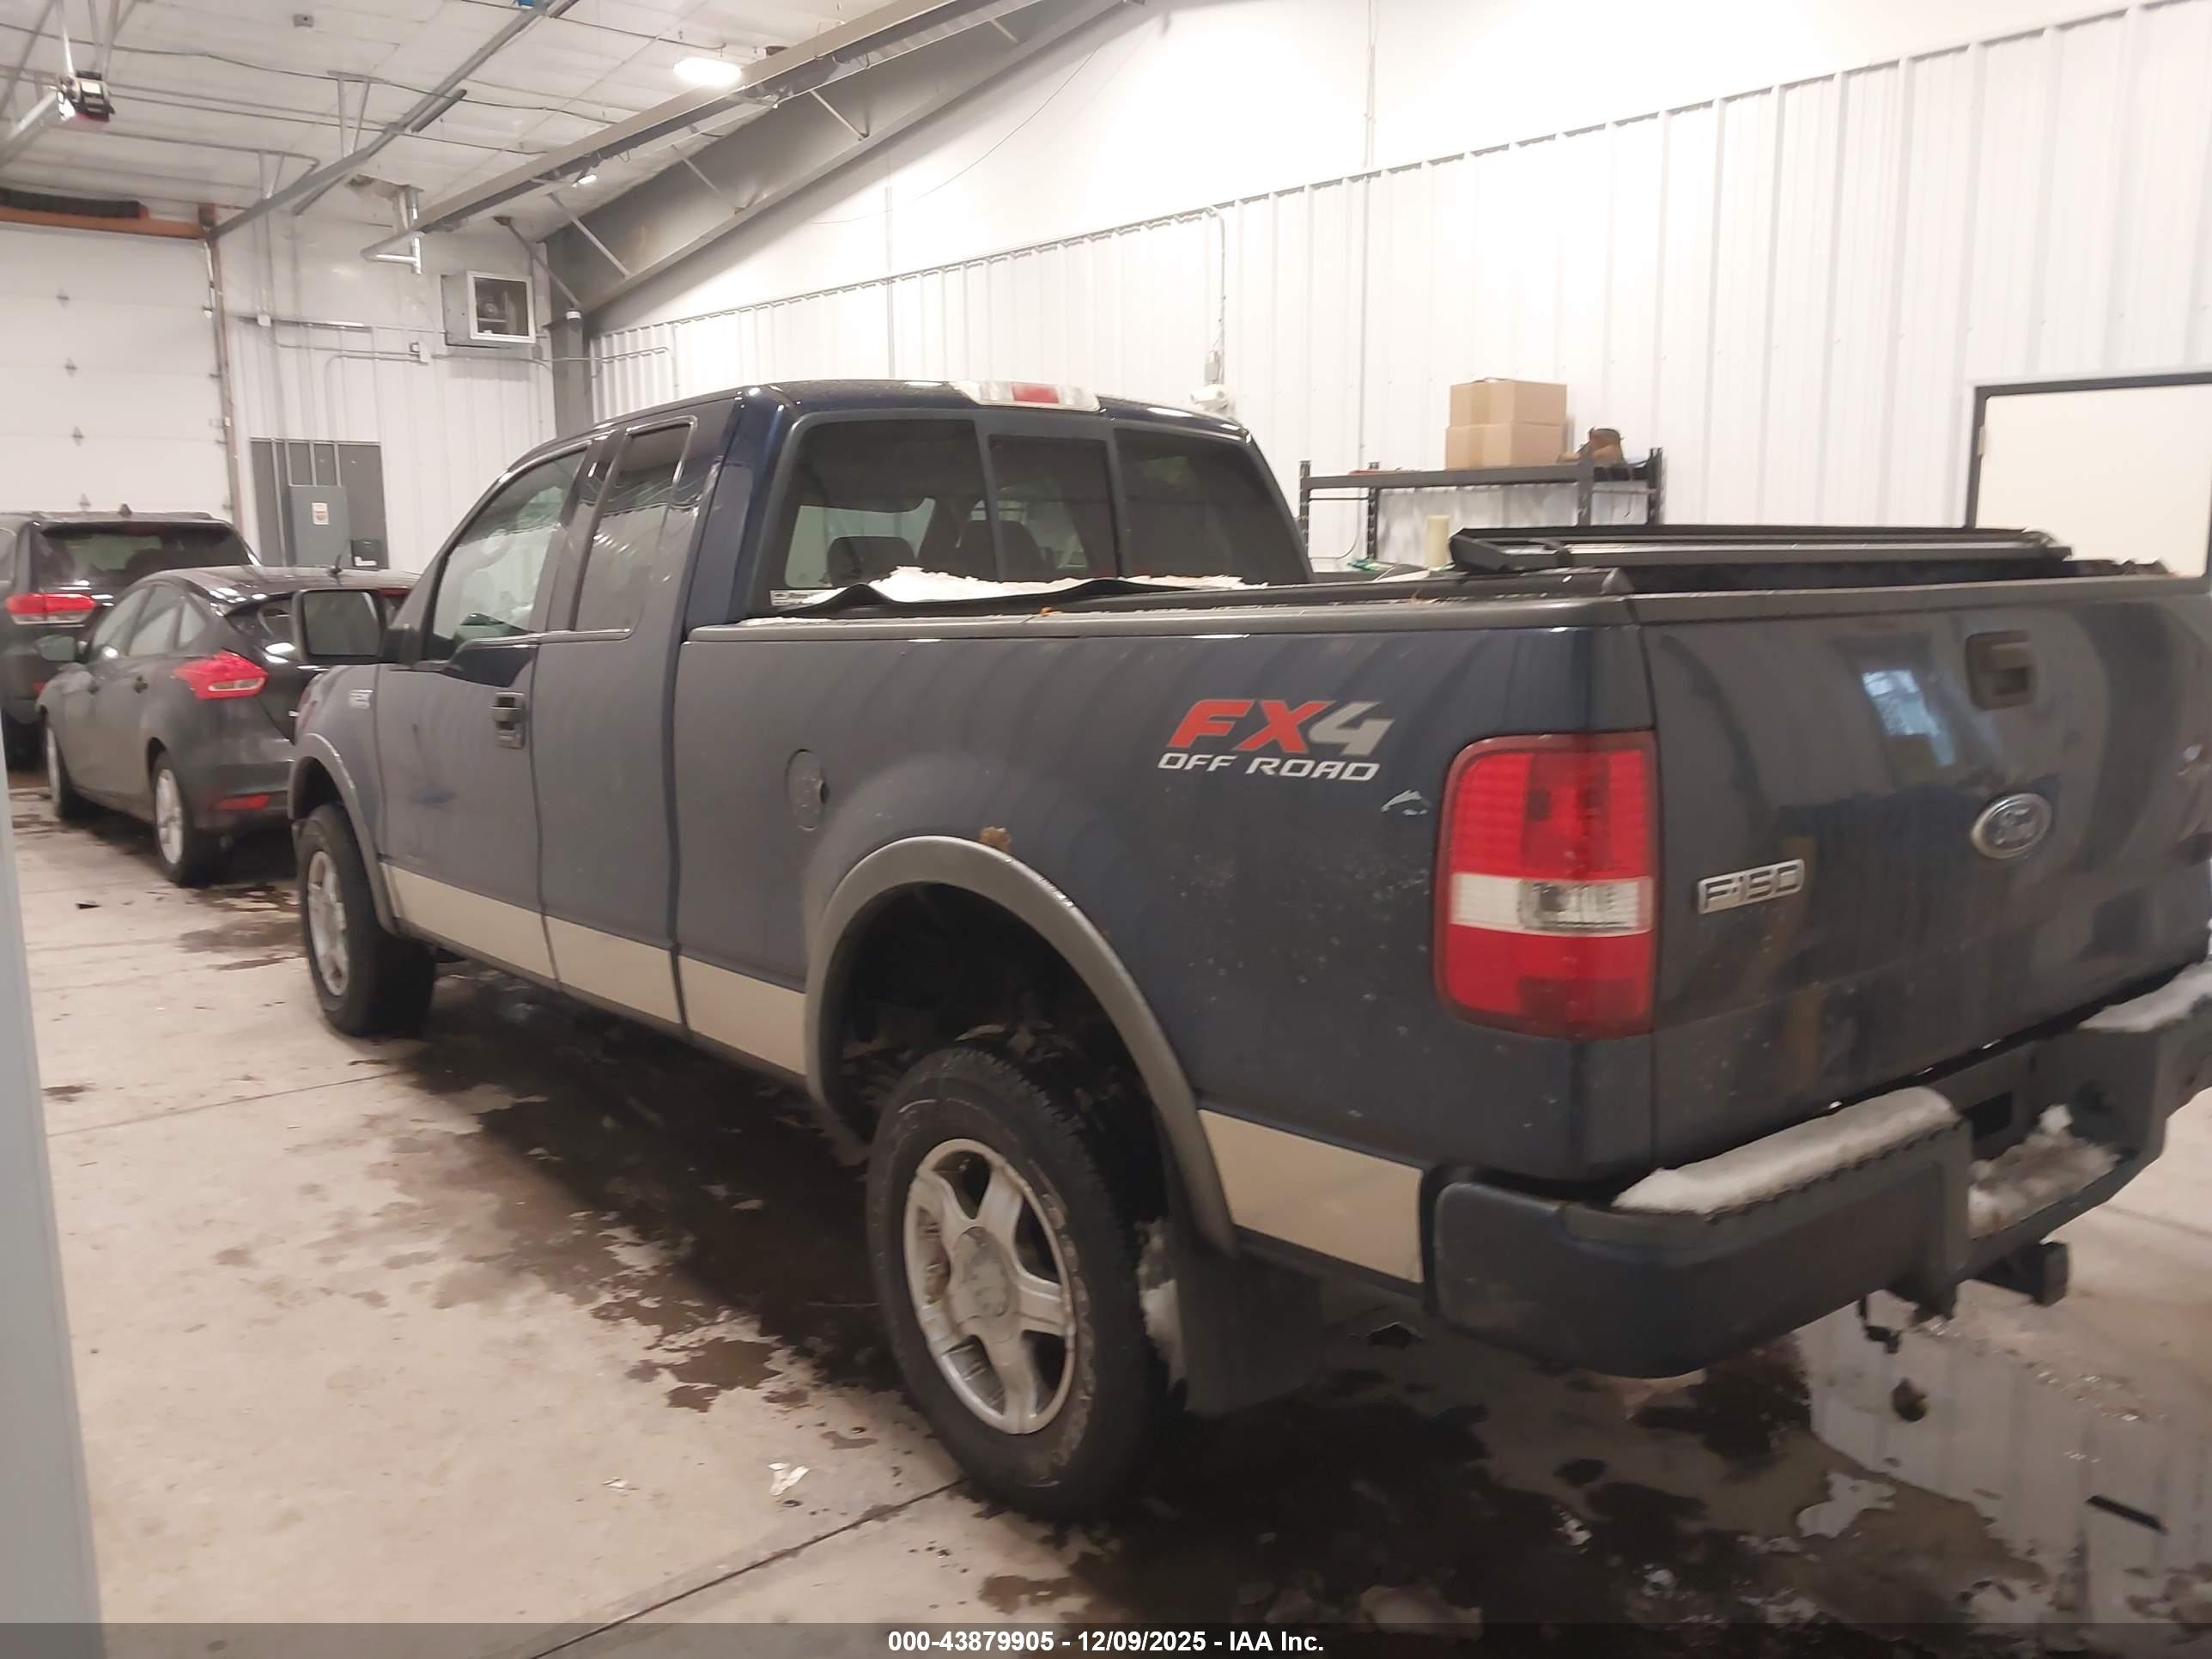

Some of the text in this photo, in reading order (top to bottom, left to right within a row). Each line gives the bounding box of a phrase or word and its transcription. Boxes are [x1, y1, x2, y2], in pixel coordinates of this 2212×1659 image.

[1166, 698, 1395, 757] FX4
[1158, 752, 1380, 781] OFF ROAD
